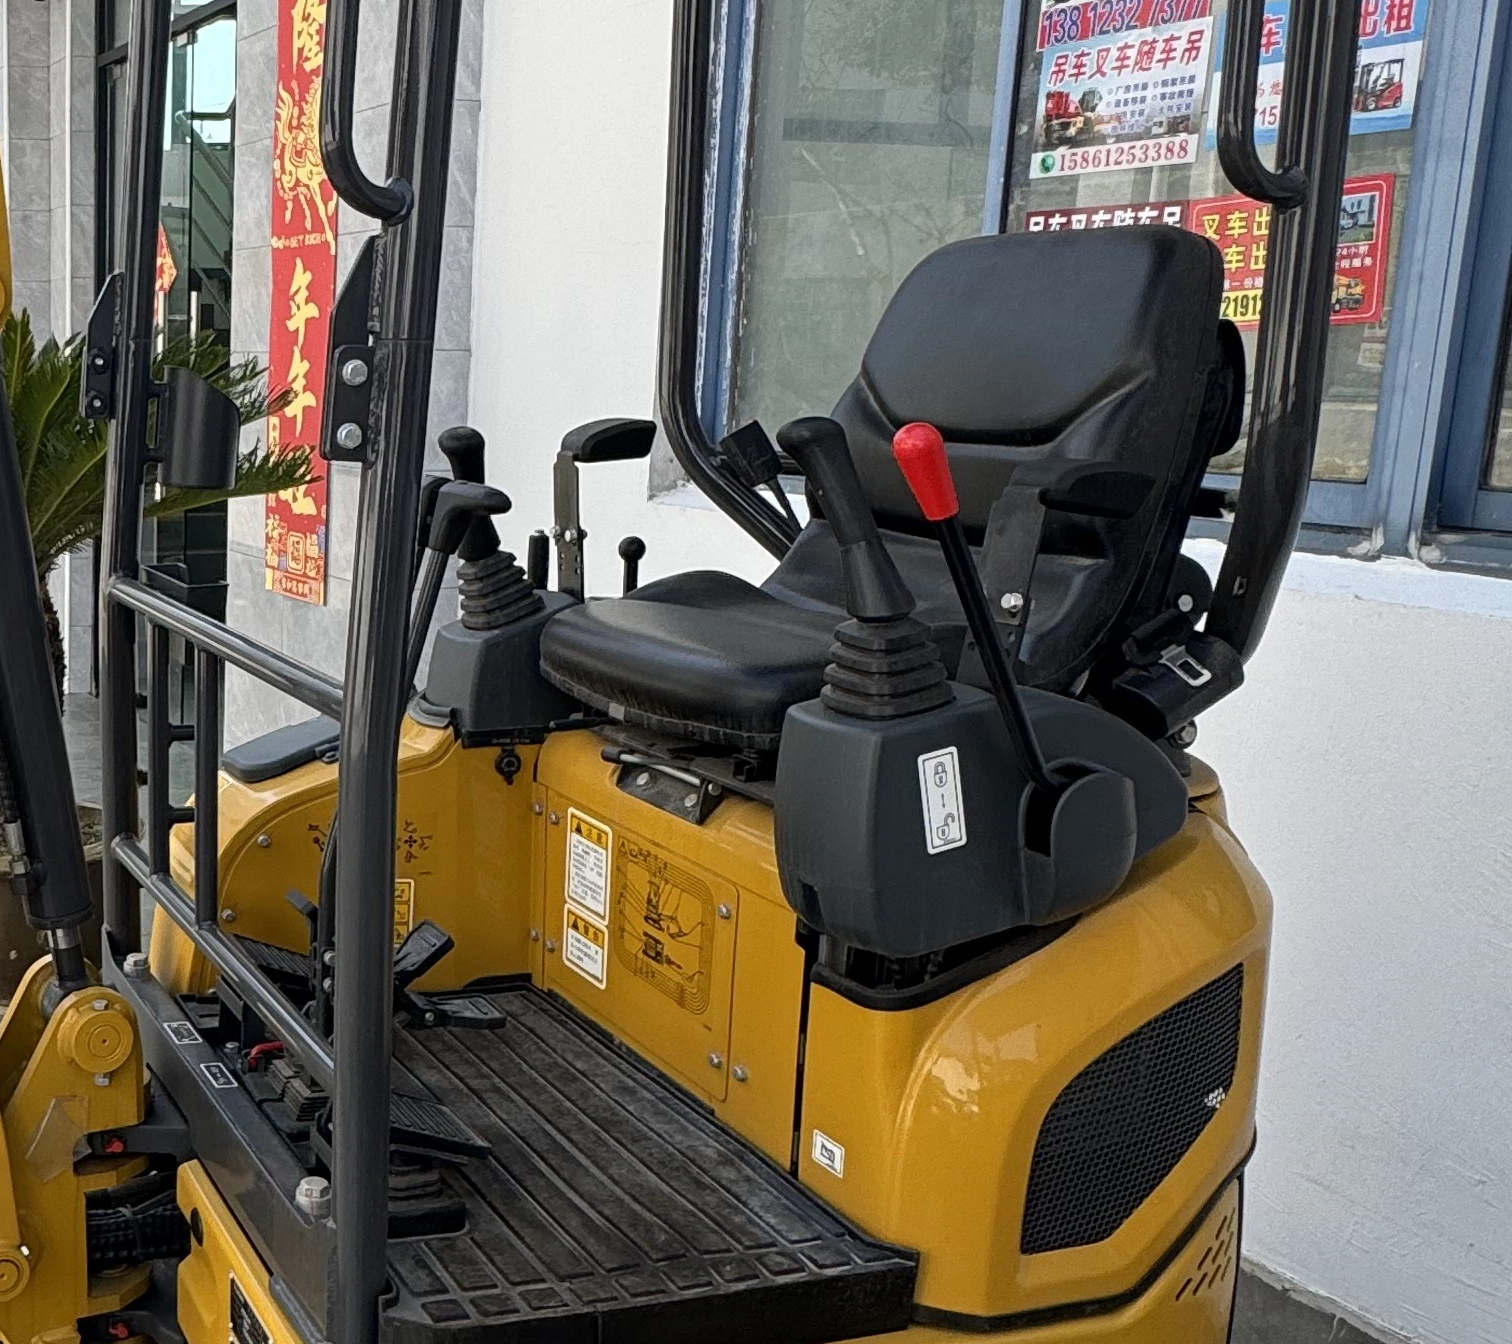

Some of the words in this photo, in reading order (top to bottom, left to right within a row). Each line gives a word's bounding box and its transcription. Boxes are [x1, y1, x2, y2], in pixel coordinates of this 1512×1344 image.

[1044, 5, 1082, 46] 138
[1047, 28, 1206, 87] 吊车叉车随车吊
[1059, 139, 1189, 172] 15861253388
[1221, 294, 1263, 318] 2191
